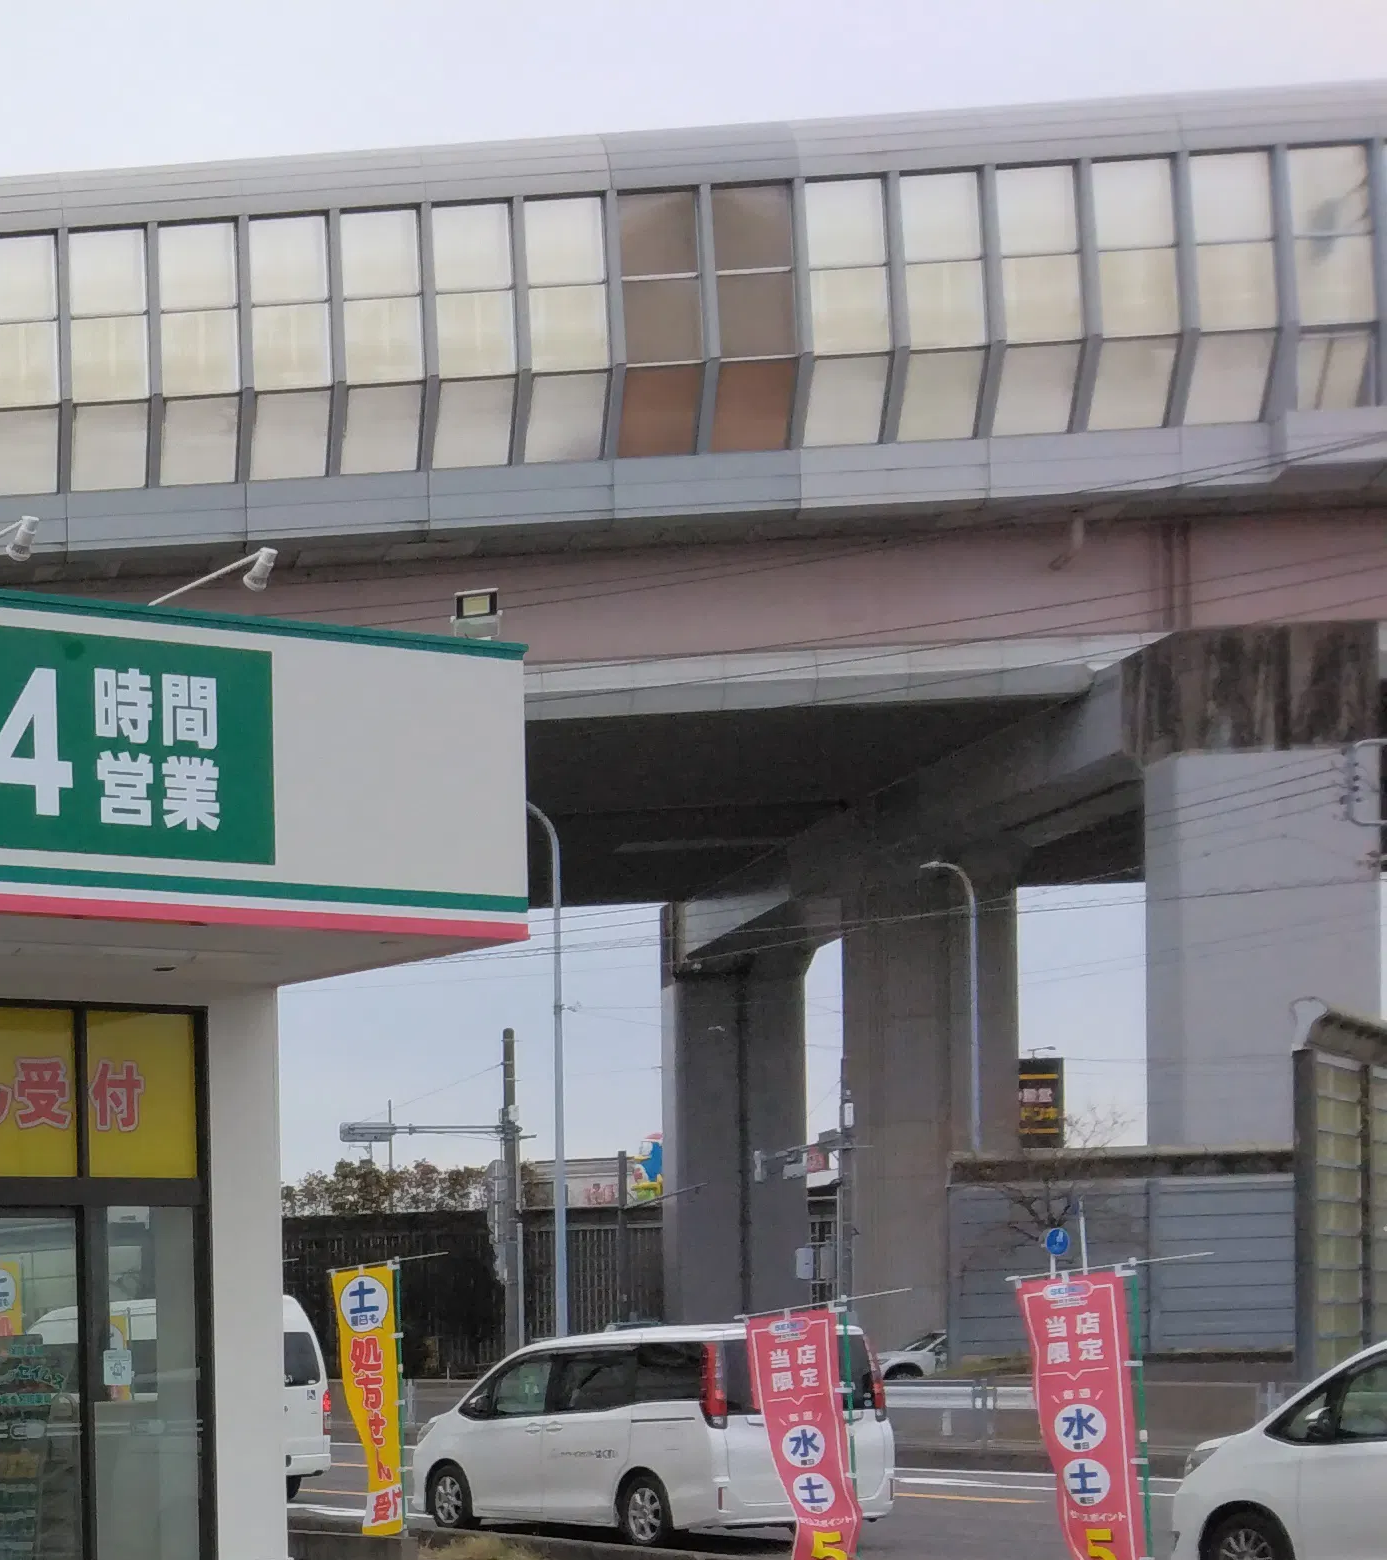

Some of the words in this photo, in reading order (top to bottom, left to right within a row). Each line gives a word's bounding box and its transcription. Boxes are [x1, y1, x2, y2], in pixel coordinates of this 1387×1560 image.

[92, 666, 219, 750] 時間
[96, 749, 222, 833] 営業
[348, 1280, 380, 1315] 土
[1044, 1311, 1101, 1338] 当店
[769, 1344, 817, 1369] 当店
[1046, 1337, 1105, 1365] 限定
[770, 1368, 820, 1393] 限定
[349, 1335, 393, 1482] 処方せん
[1061, 1407, 1099, 1441] 水
[788, 1428, 821, 1458] 水
[798, 1476, 829, 1504] 土
[1068, 1462, 1102, 1495] 土
